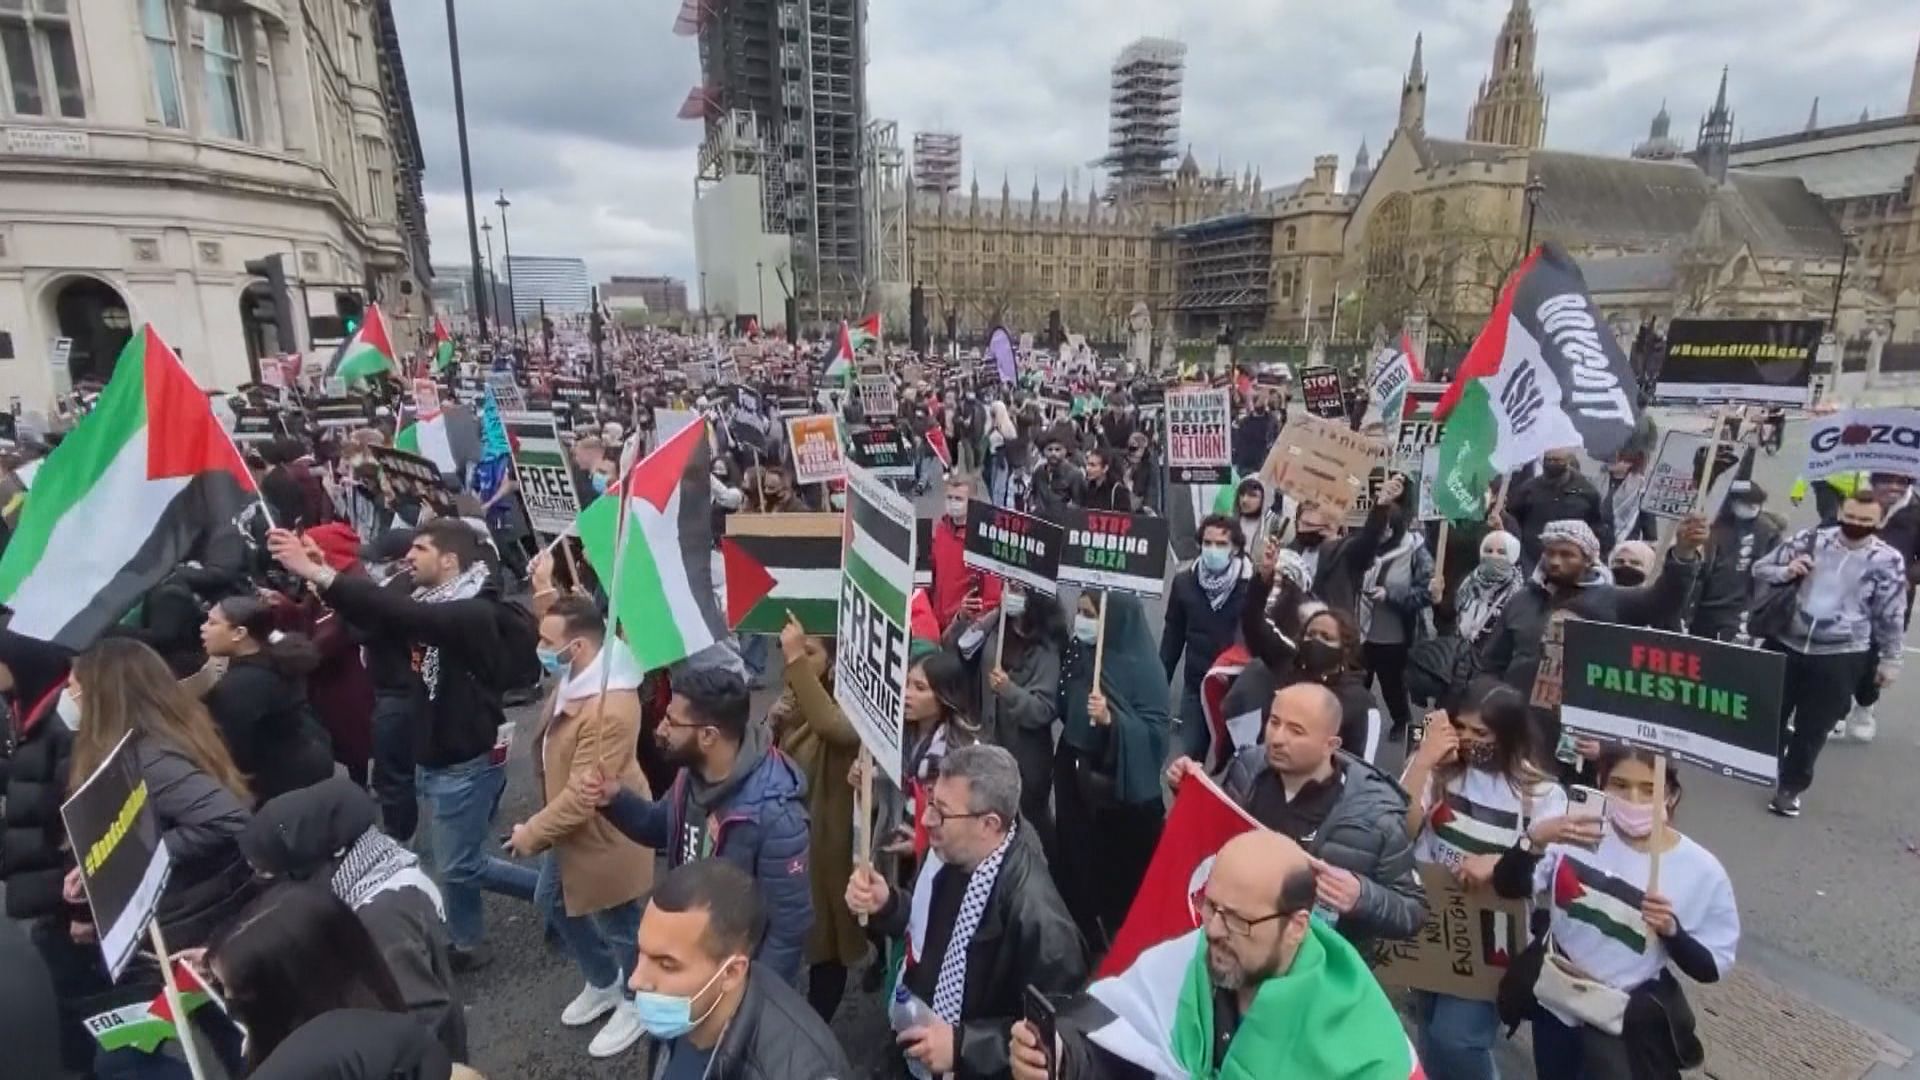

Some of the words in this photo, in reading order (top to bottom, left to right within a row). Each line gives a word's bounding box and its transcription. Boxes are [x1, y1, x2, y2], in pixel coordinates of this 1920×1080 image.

[1536, 293, 1636, 427] BOYCOTT
[1303, 374, 1337, 389] STOP
[1171, 424, 1226, 435] RESIST!
[1399, 422, 1447, 444] FRE
[1172, 436, 1226, 460] RETURN!
[517, 466, 573, 497] FREE
[524, 494, 578, 512] PALESTINE
[993, 512, 1029, 533] STOP
[1088, 514, 1131, 535] STOP
[979, 522, 1045, 556] BOMBING
[1069, 529, 1149, 556] BOMBING
[992, 542, 1028, 566] GAZA
[1084, 549, 1127, 570] GAZA
[840, 573, 904, 696] FREE
[1631, 645, 1702, 679] FREE
[1586, 662, 1748, 720] PALESTINE
[89, 1012, 124, 1033] FOA
